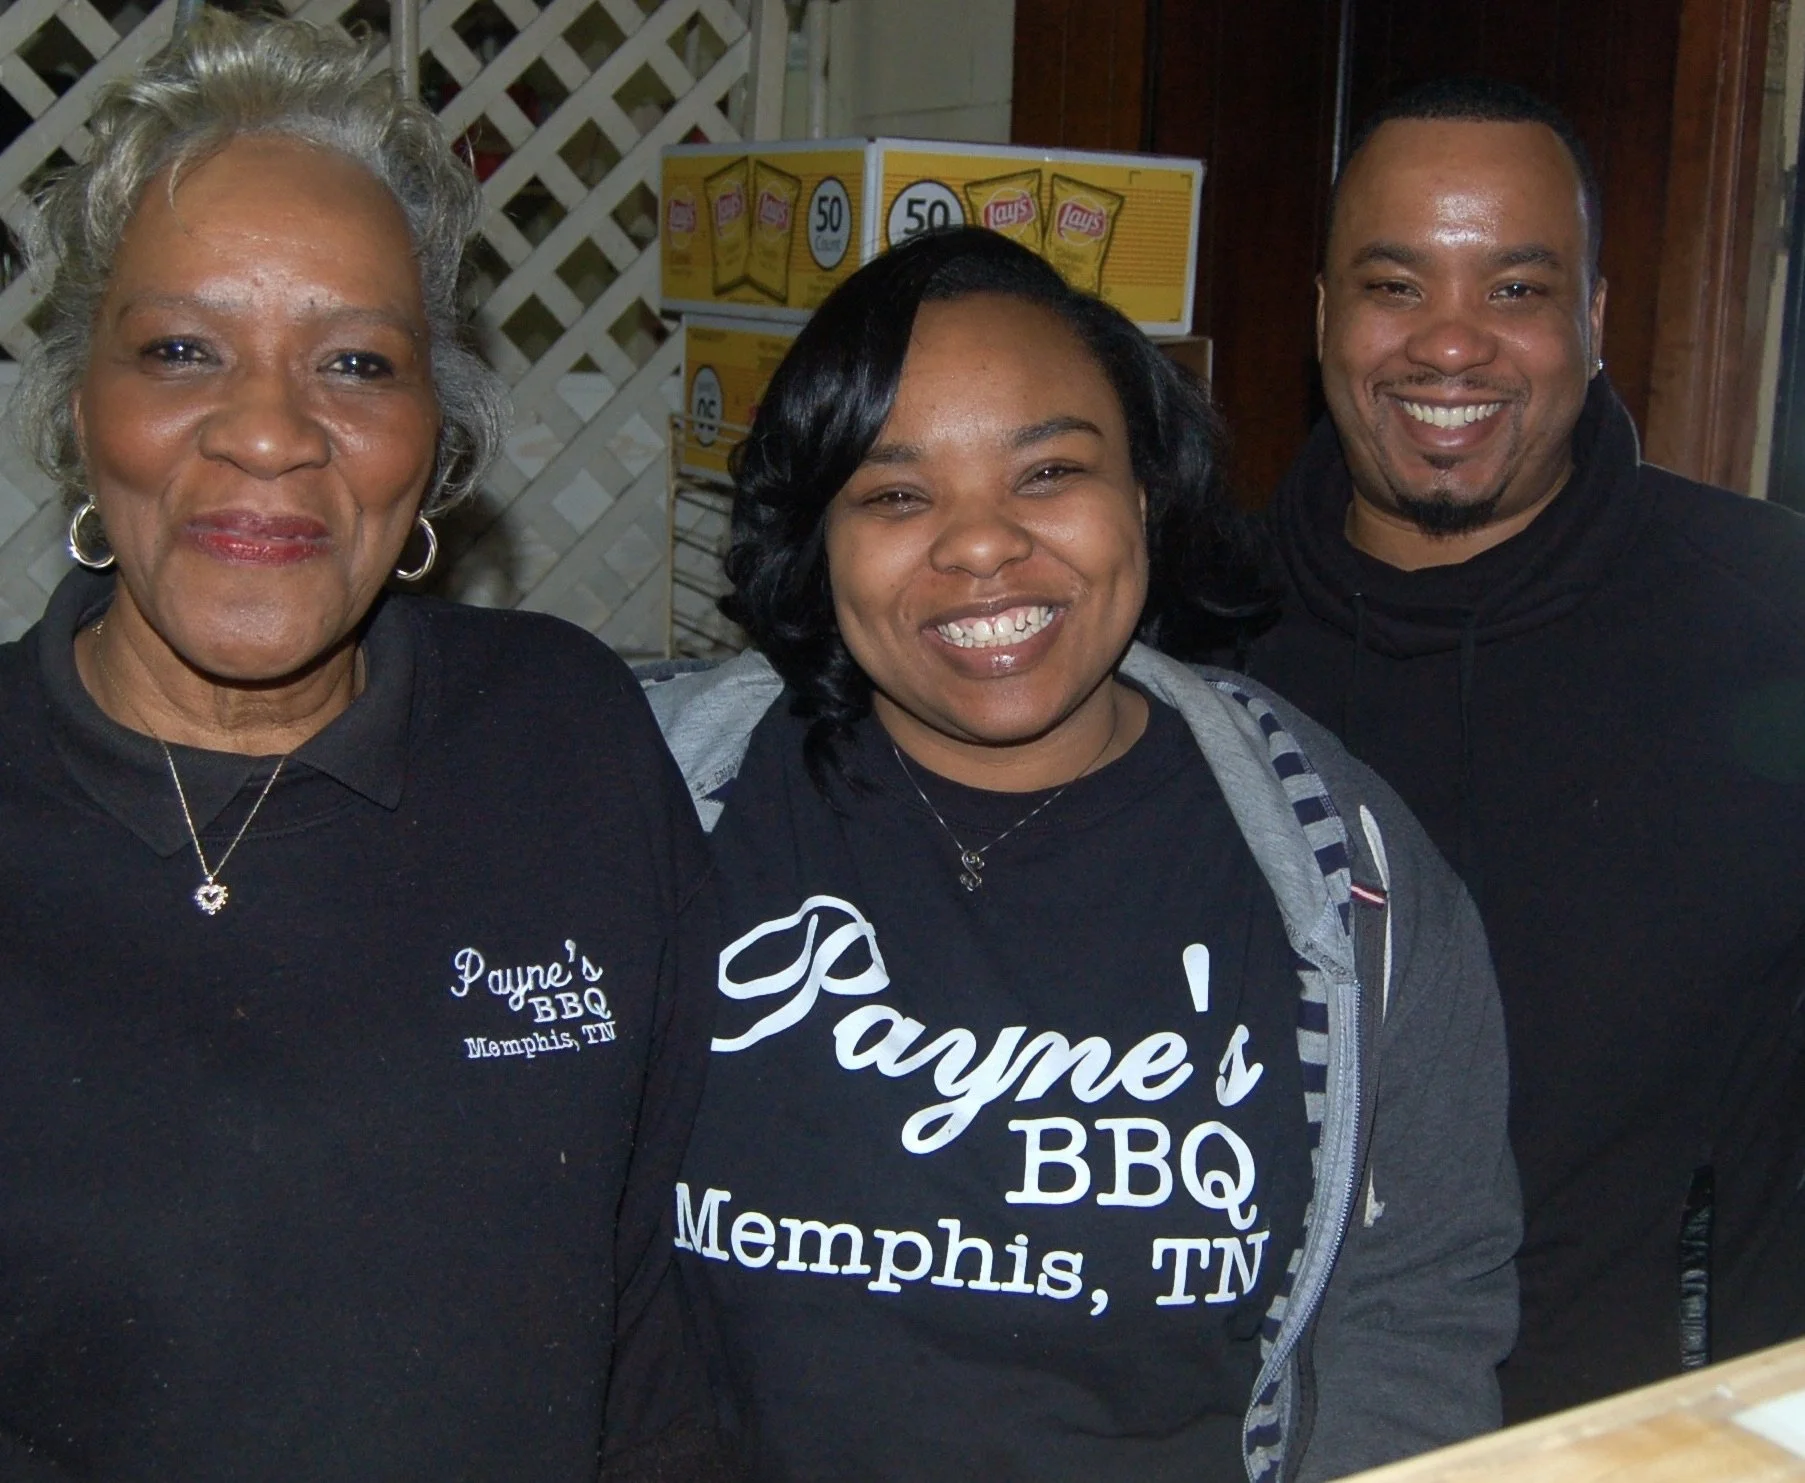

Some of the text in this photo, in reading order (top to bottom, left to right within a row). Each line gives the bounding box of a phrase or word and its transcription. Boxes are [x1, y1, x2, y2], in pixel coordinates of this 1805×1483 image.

[815, 195, 842, 233] 50
[904, 197, 949, 235] 50
[450, 938, 604, 1012] Payne's
[527, 986, 613, 1024] BBQ
[711, 894, 1264, 1155] Payne's
[463, 1020, 617, 1059] Memphis, TN
[1004, 1116, 1258, 1231] BBQ
[673, 1182, 1271, 1317] Memphis, TN
